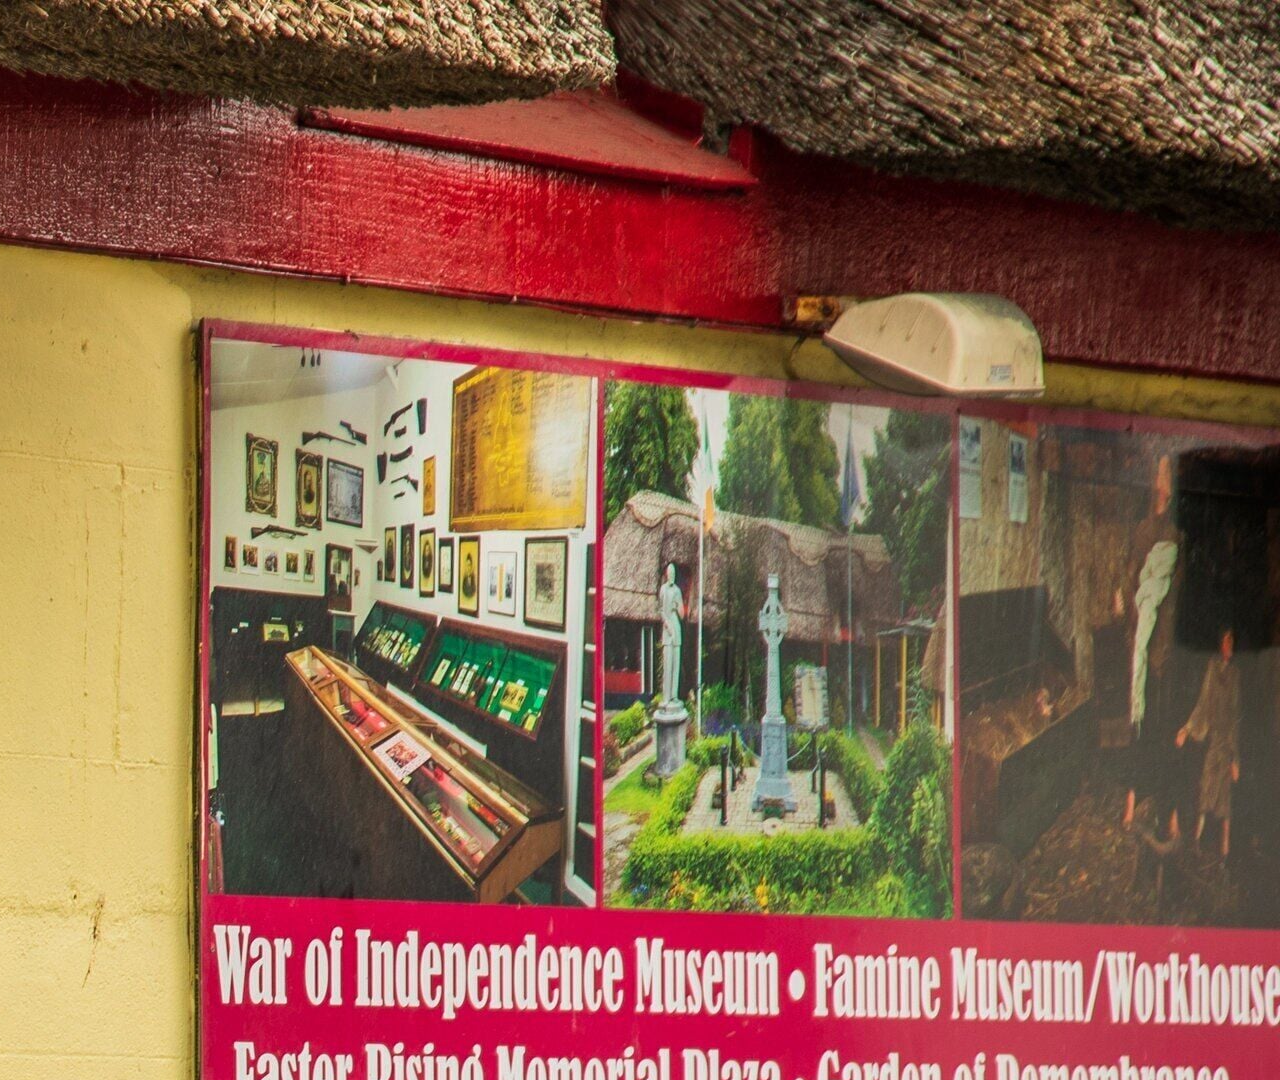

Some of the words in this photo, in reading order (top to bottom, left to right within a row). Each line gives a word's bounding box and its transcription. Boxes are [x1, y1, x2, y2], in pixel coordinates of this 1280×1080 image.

[213, 924, 292, 1005] War
[304, 927, 344, 1006] of
[355, 928, 624, 1020] Independence
[634, 937, 780, 1016] Museum
[813, 943, 941, 1020] Famine
